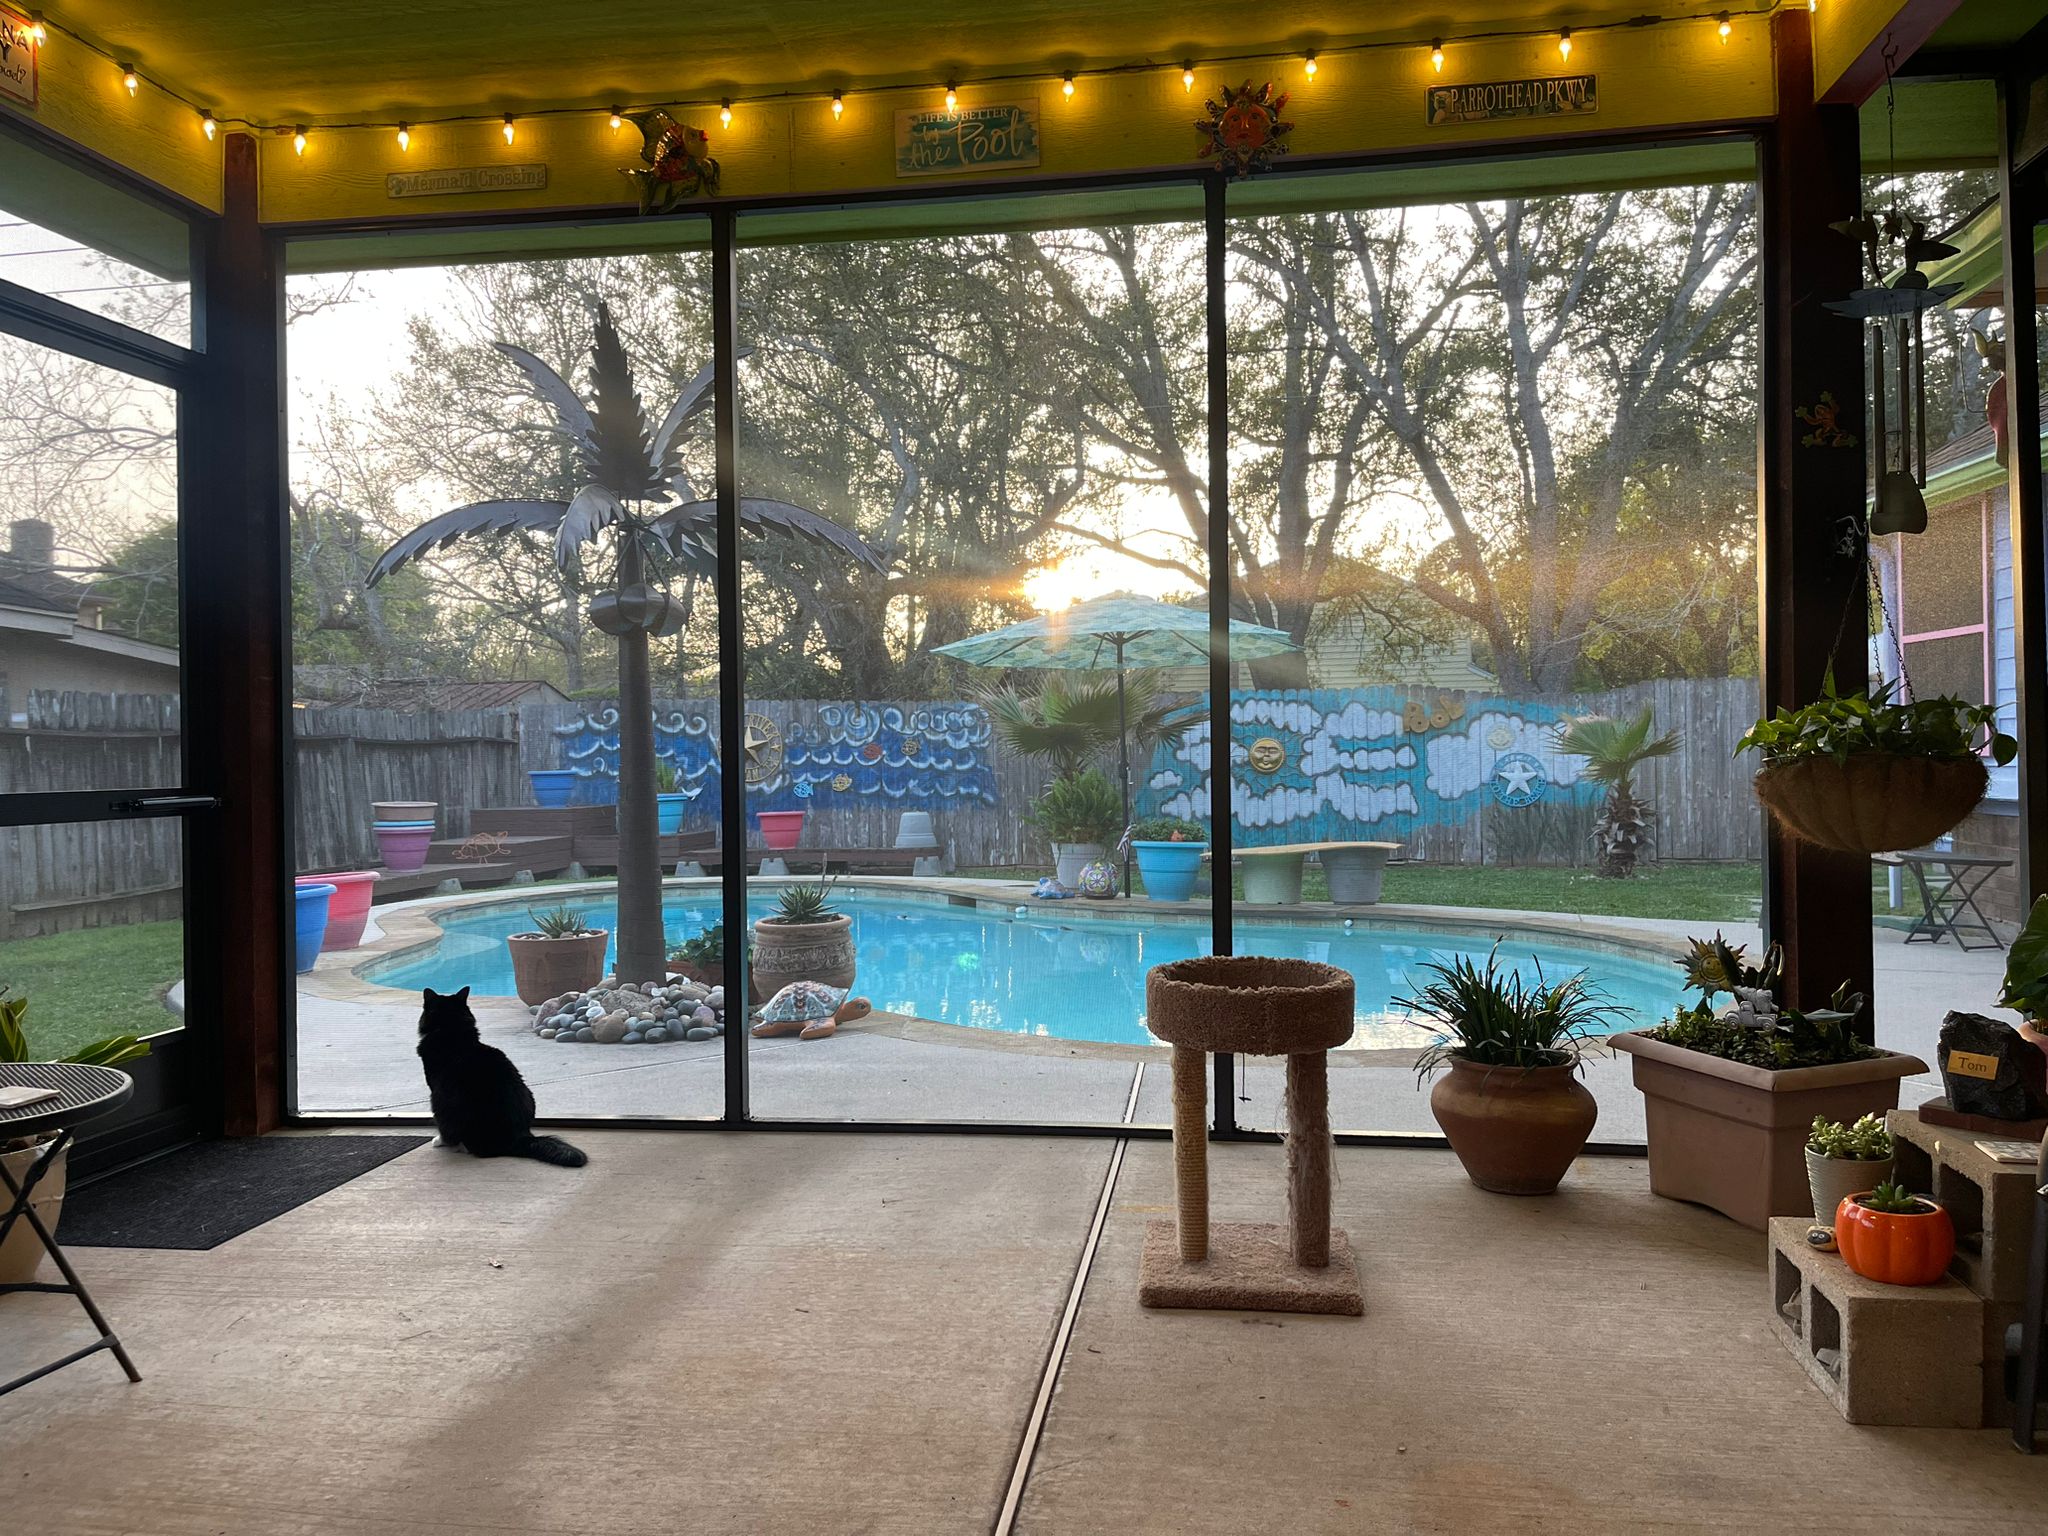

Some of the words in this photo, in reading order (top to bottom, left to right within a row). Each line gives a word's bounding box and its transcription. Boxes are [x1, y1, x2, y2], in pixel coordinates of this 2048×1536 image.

[1451, 82, 1544, 113] PARROTHEAD
[1547, 78, 1589, 104] PKWY
[918, 112, 944, 124] LIFE
[947, 111, 958, 122] IS
[961, 108, 1009, 121] BETTER
[908, 142, 950, 168] the
[953, 109, 1024, 164] Pool
[406, 172, 474, 192] Mermaid
[479, 168, 545, 187] Crossing
[1958, 1056, 1987, 1073] Tom
